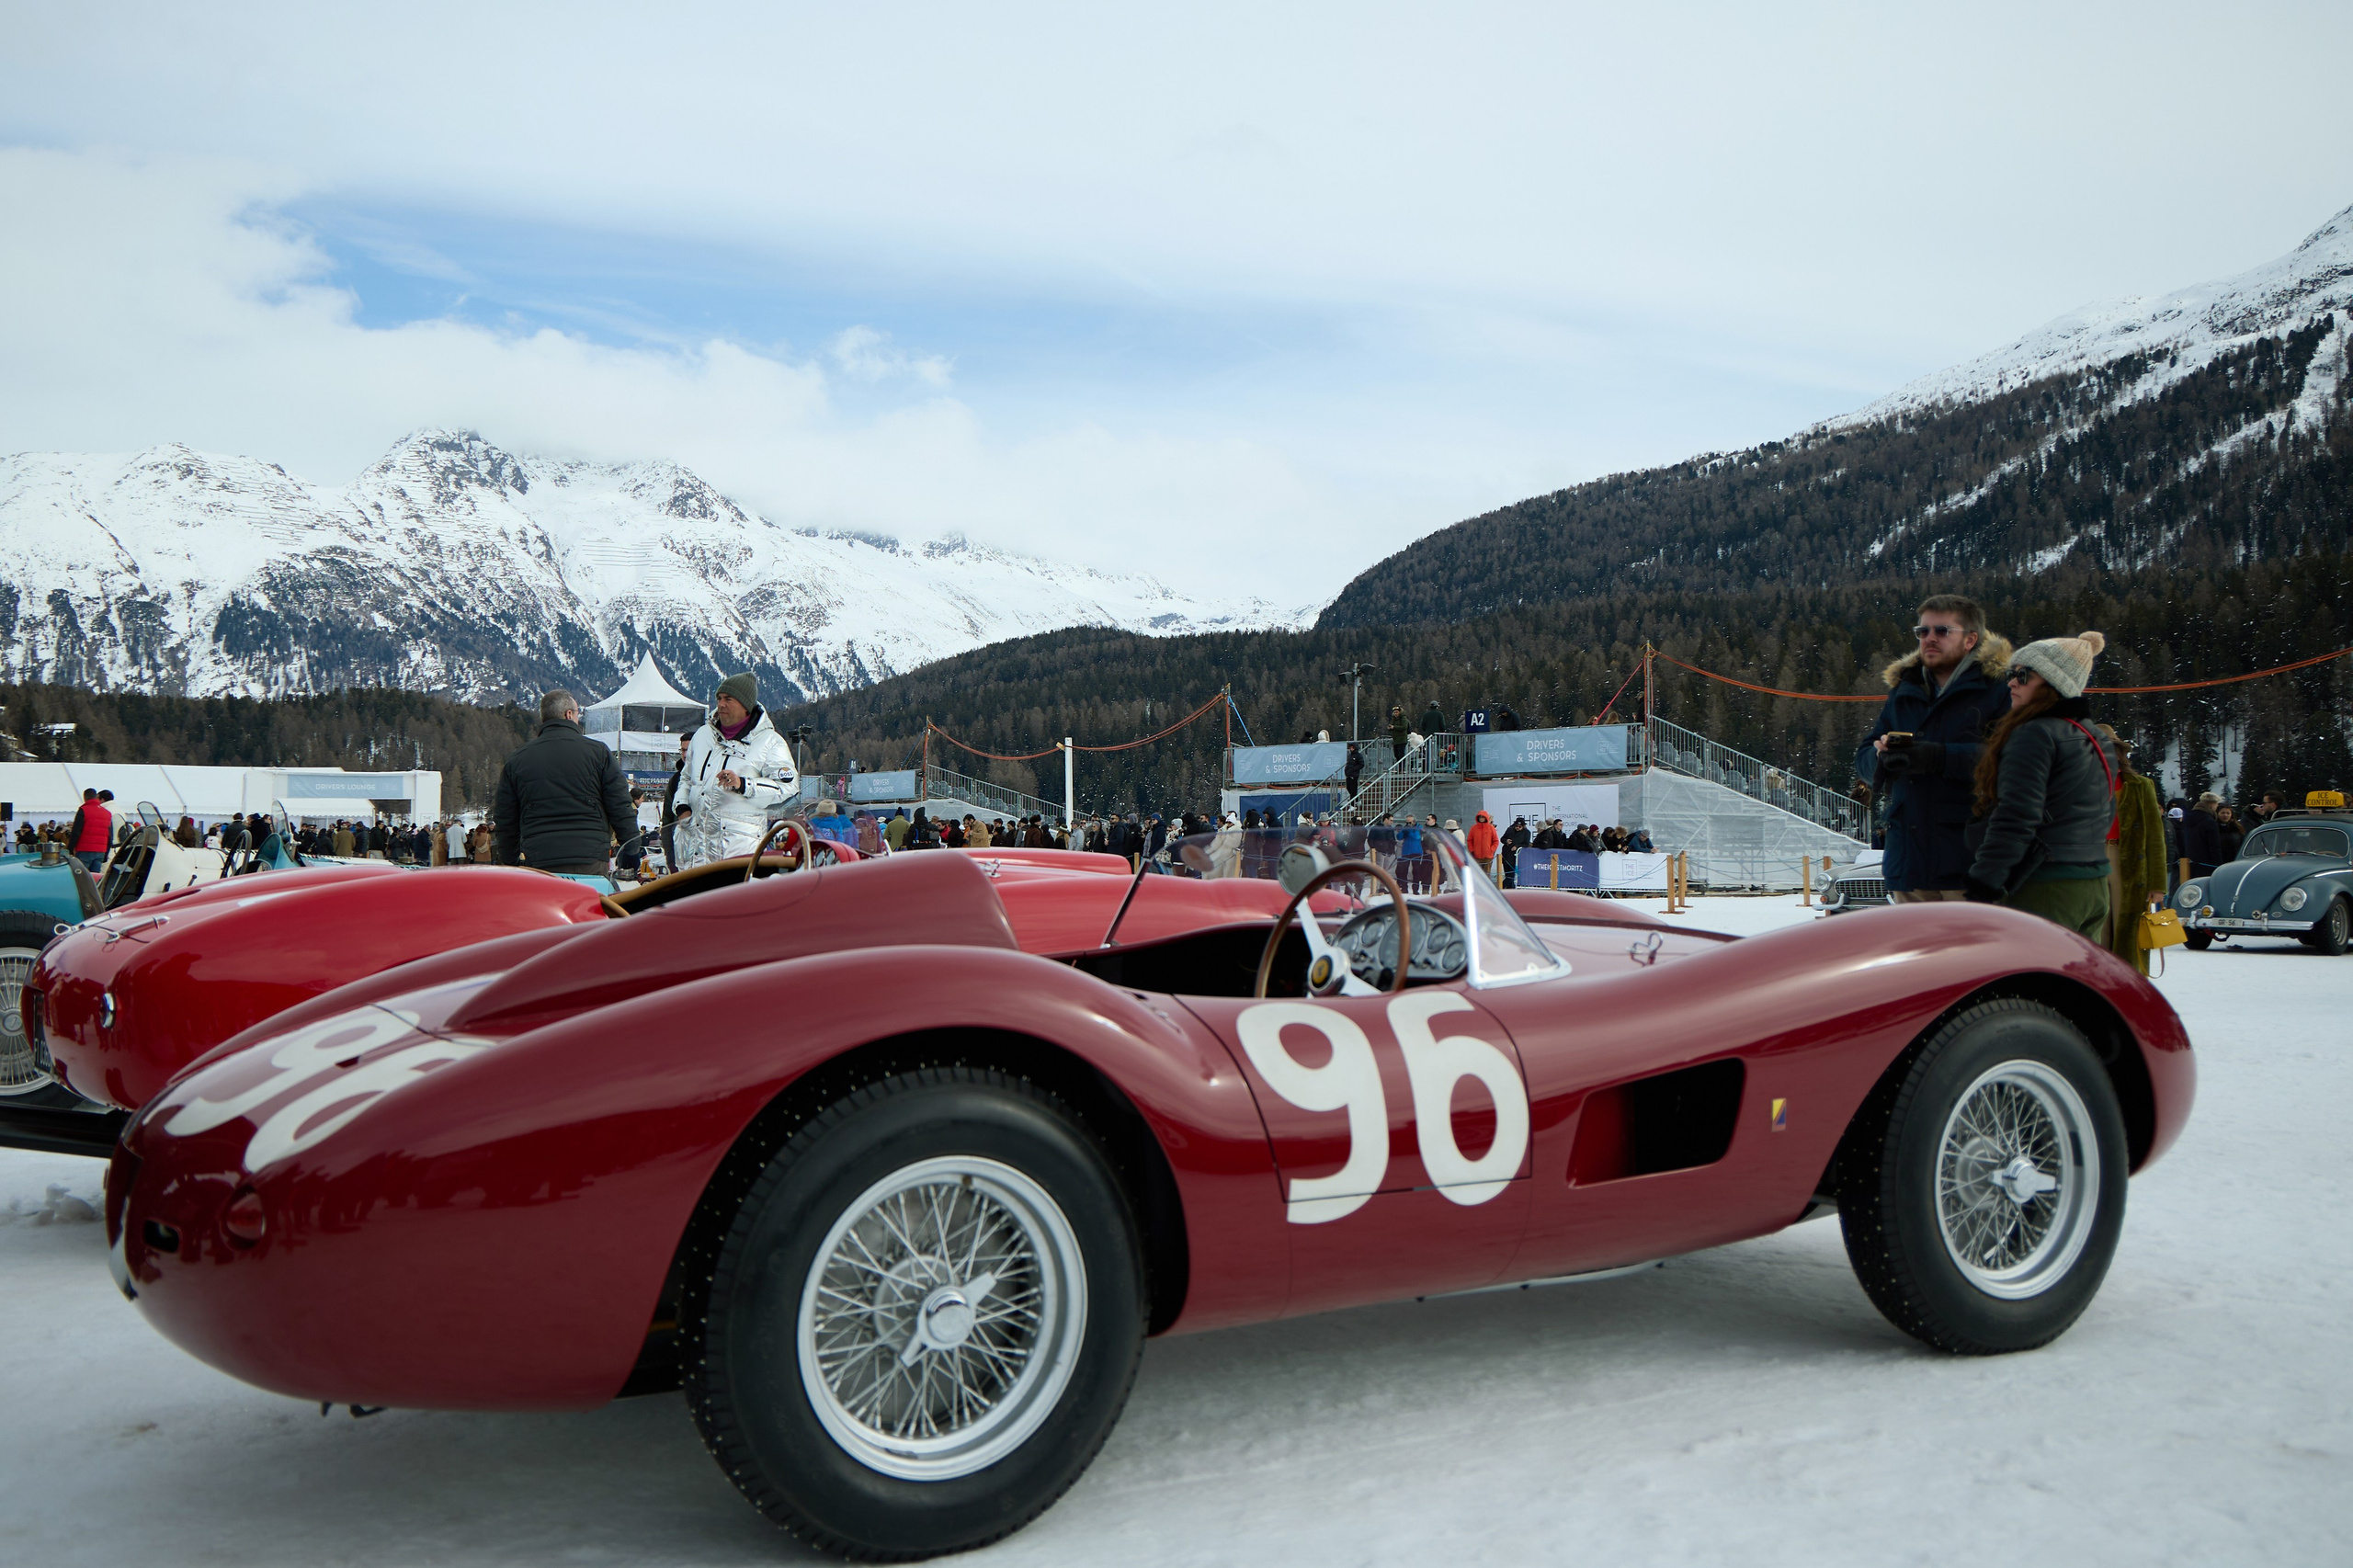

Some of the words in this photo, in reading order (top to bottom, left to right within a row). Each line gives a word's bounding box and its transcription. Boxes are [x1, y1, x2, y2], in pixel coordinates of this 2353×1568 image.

[1471, 712, 1485, 726] A2
[1527, 739, 1564, 751] DRIVERS
[1272, 754, 1301, 764] DRIVERS
[1517, 754, 1523, 763] &
[1528, 750, 1576, 762] SPONSORS
[850, 760, 857, 769] A1
[1265, 765, 1271, 774] &
[1273, 763, 1311, 773] SPONSORS
[164, 1010, 498, 1174] 96
[1236, 991, 1529, 1224] 96
